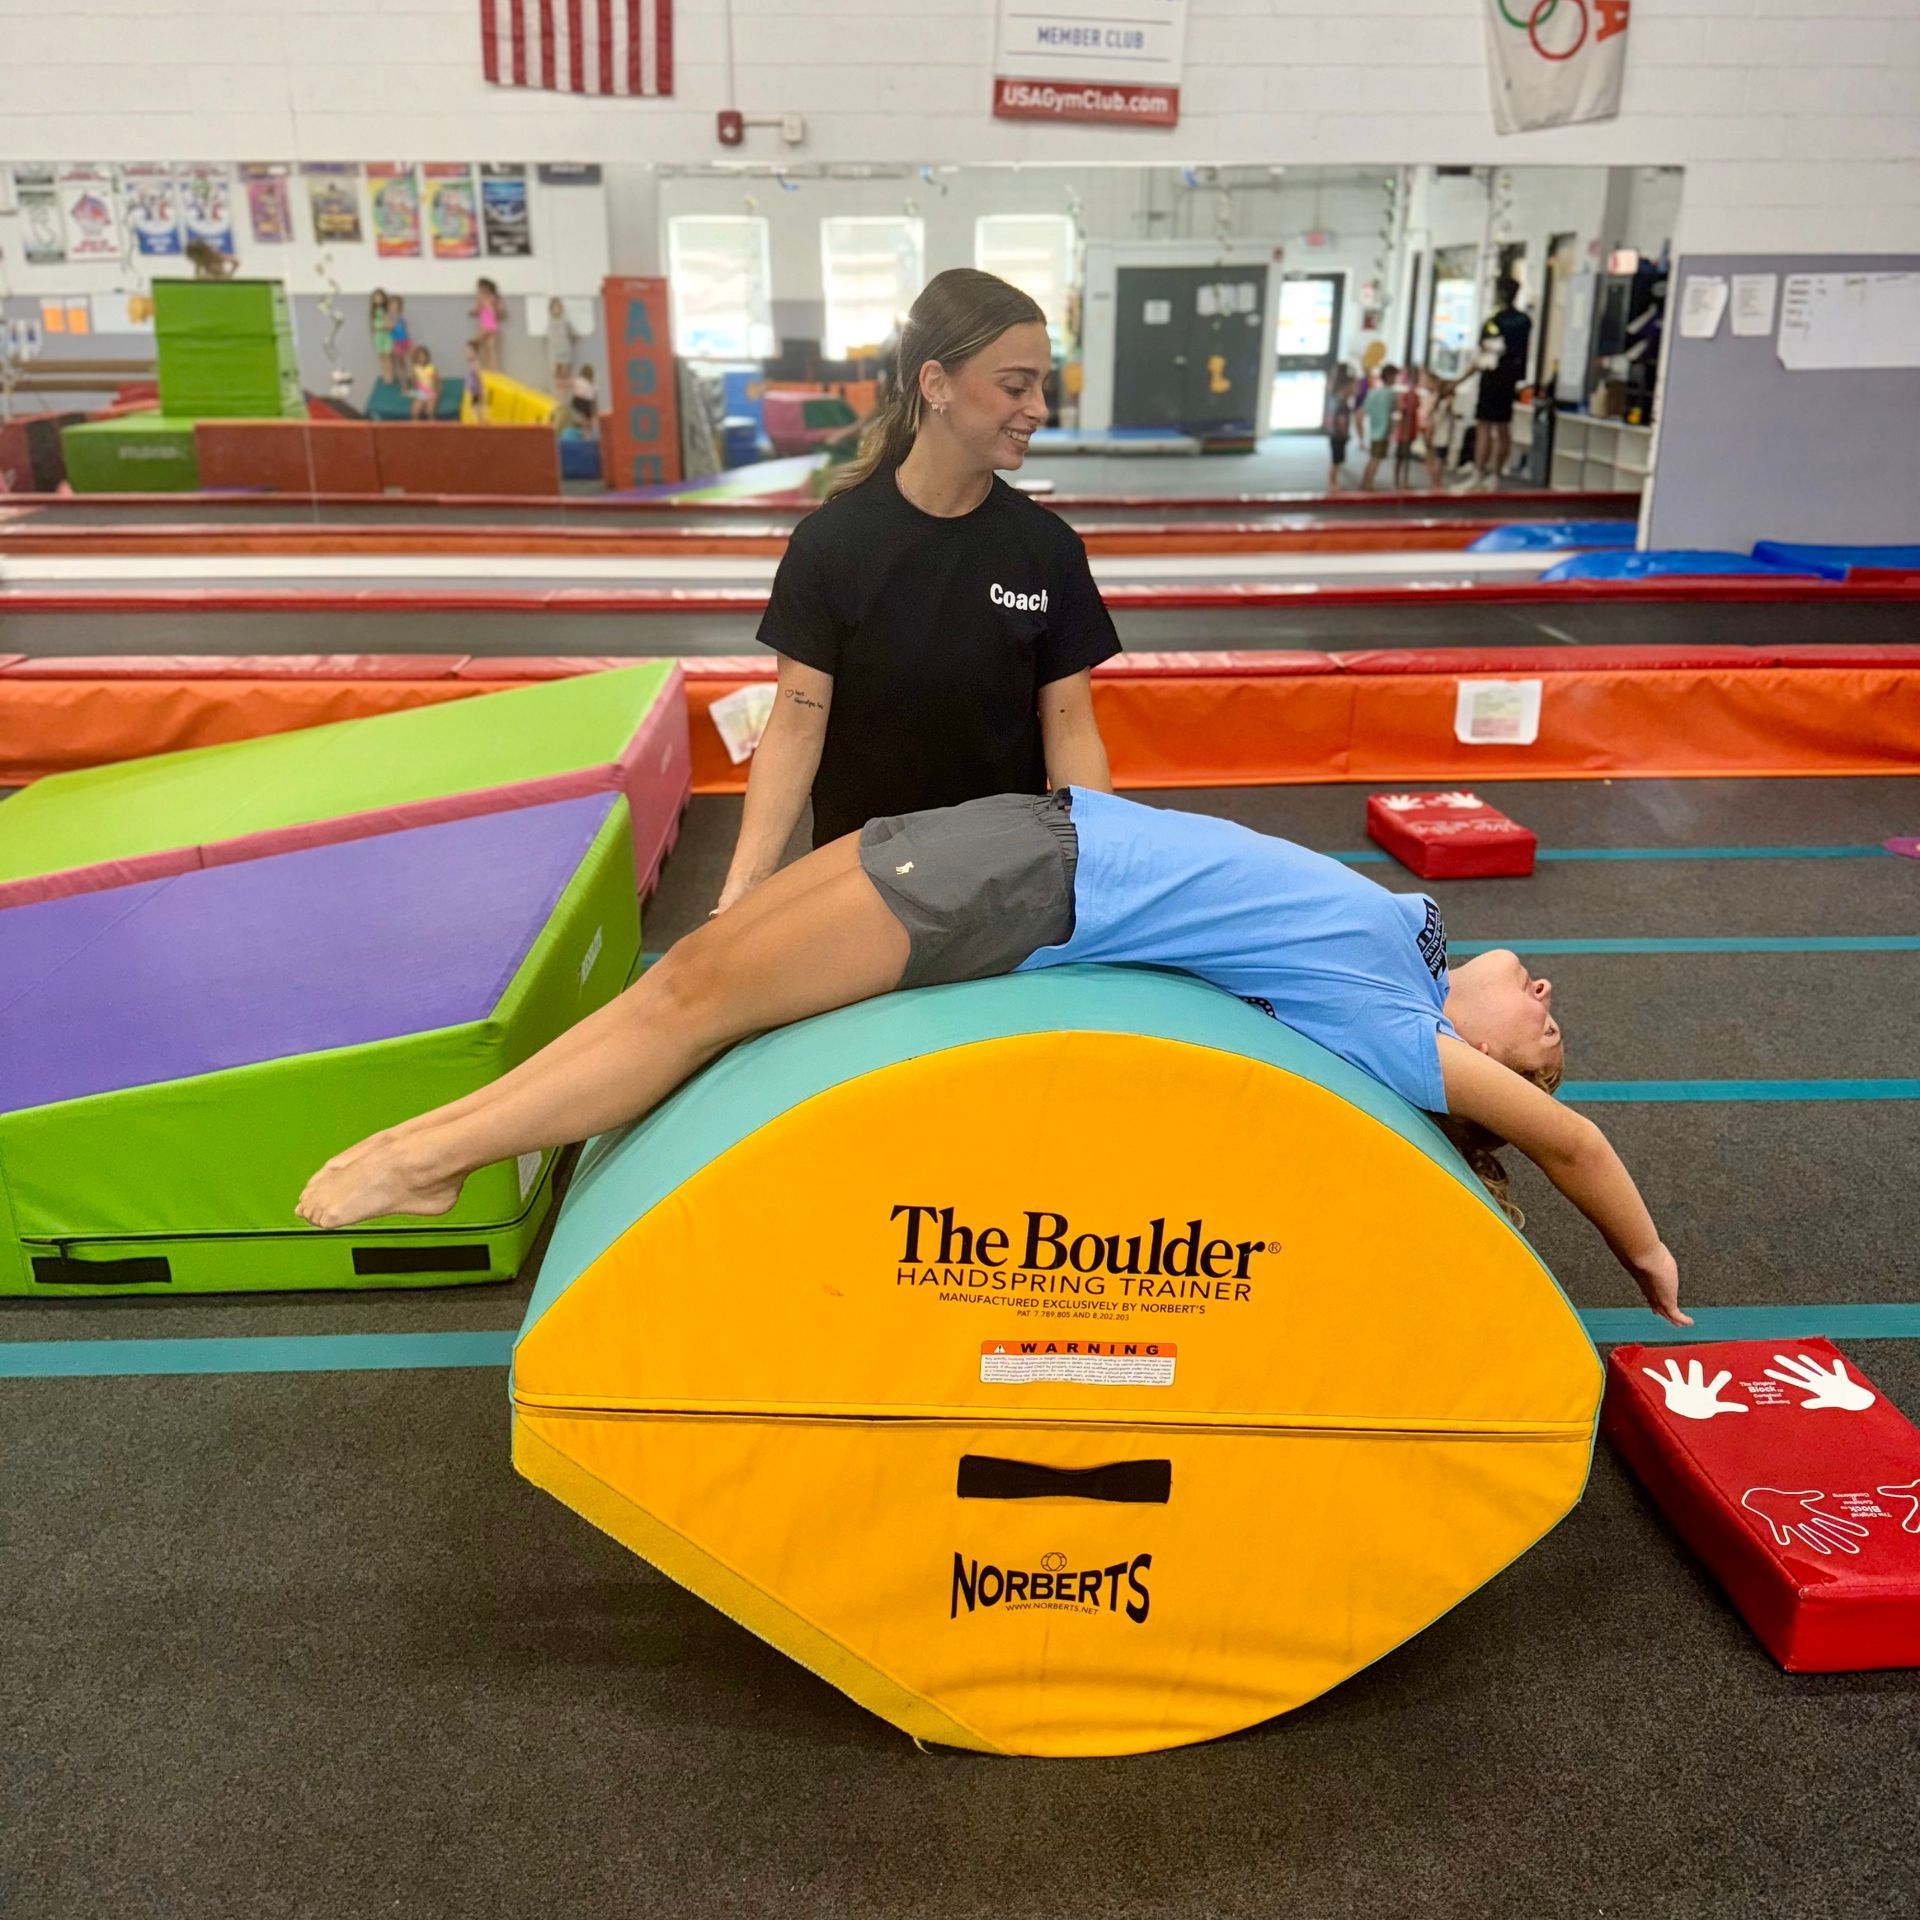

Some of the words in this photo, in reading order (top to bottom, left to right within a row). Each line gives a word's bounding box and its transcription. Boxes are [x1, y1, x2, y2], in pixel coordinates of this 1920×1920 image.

[1037, 27, 1101, 46] MEMBER
[1105, 30, 1143, 48] CLUB
[1003, 86, 1168, 113] USAGymClub.com
[990, 583, 1048, 613] Coach
[890, 1204, 1009, 1267] The
[896, 1267, 1105, 1296] HANDSPRING
[1119, 1278, 1251, 1302] TRAINER
[939, 1292, 1038, 1308] MANUFACTURED
[1043, 1299, 1118, 1311] EXCLUSIVELY
[1122, 1302, 1137, 1311] BY
[1140, 1303, 1206, 1314] NORBERT'S
[1020, 1343, 1159, 1355] WARNING
[1748, 1385, 1777, 1393] Block
[951, 1551, 1152, 1624] NORBERTS
[1005, 1602, 1098, 1615] WWW.NORBERTS.NET
